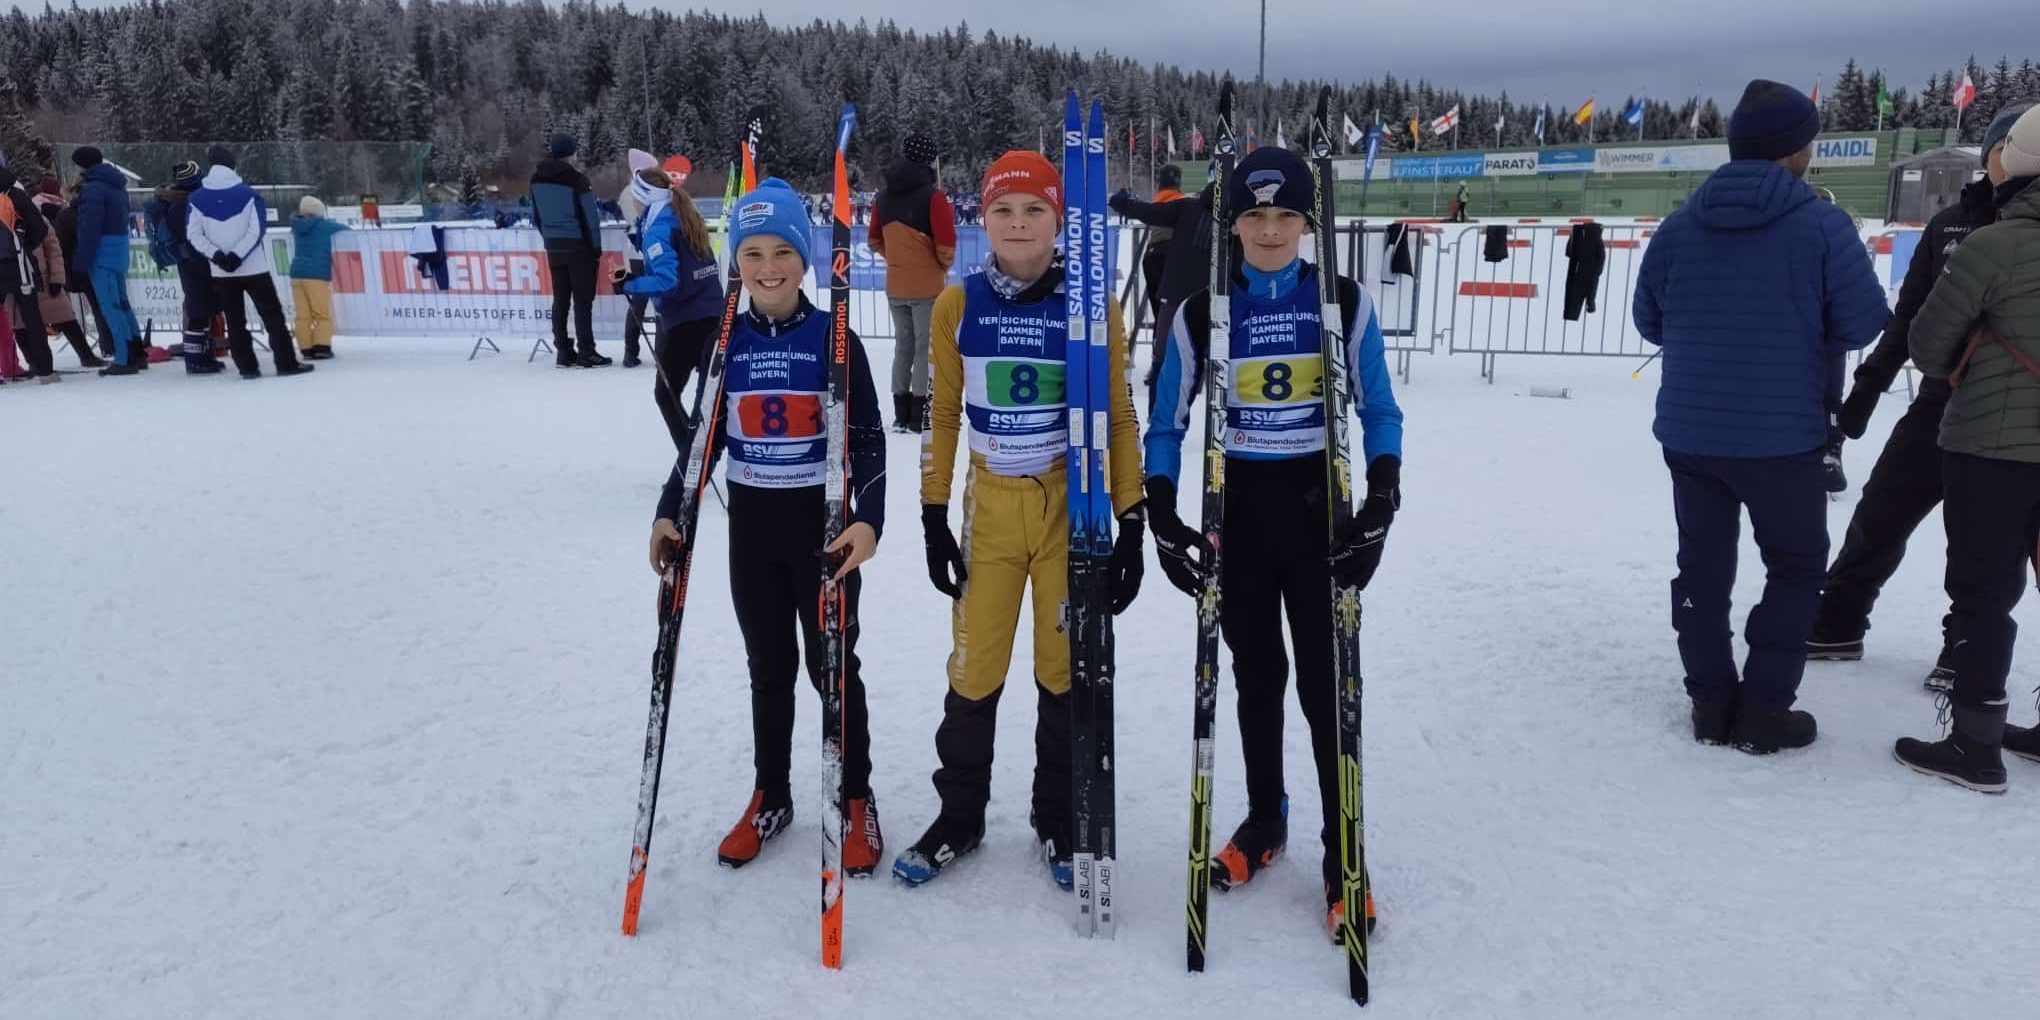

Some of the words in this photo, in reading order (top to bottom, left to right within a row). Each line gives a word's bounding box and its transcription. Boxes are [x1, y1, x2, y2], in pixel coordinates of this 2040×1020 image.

[1816, 140, 1873, 158] HAIDL
[1611, 152, 1654, 163] WIMMER
[1212, 159, 1223, 220] FISCHER
[1313, 163, 1324, 225] FISCHER
[1068, 206, 1083, 316] SALOMON
[1090, 213, 1105, 321] SALOMON
[978, 316, 998, 325] VER
[1001, 316, 1043, 327] SICHER
[1046, 319, 1067, 329] UNG
[1251, 313, 1294, 325] SICHER
[835, 298, 847, 365] ROSSIGNOL
[1000, 326, 1043, 337] KAMMER
[1251, 323, 1294, 335] KAMMER
[1000, 336, 1042, 347] BAYERN
[1251, 334, 1294, 345] BAYERN
[752, 351, 788, 361] SICHER
[790, 352, 817, 362] UNGS
[751, 361, 787, 370] KAMMER
[751, 370, 787, 379] BAYERN
[1009, 364, 1039, 405] 8
[1262, 362, 1293, 401] 8
[1309, 376, 1323, 397] 3
[761, 396, 789, 436] 8
[989, 412, 1022, 428] BSV
[1247, 436, 1315, 445] Blutspendedi
[743, 443, 771, 457] BSV
